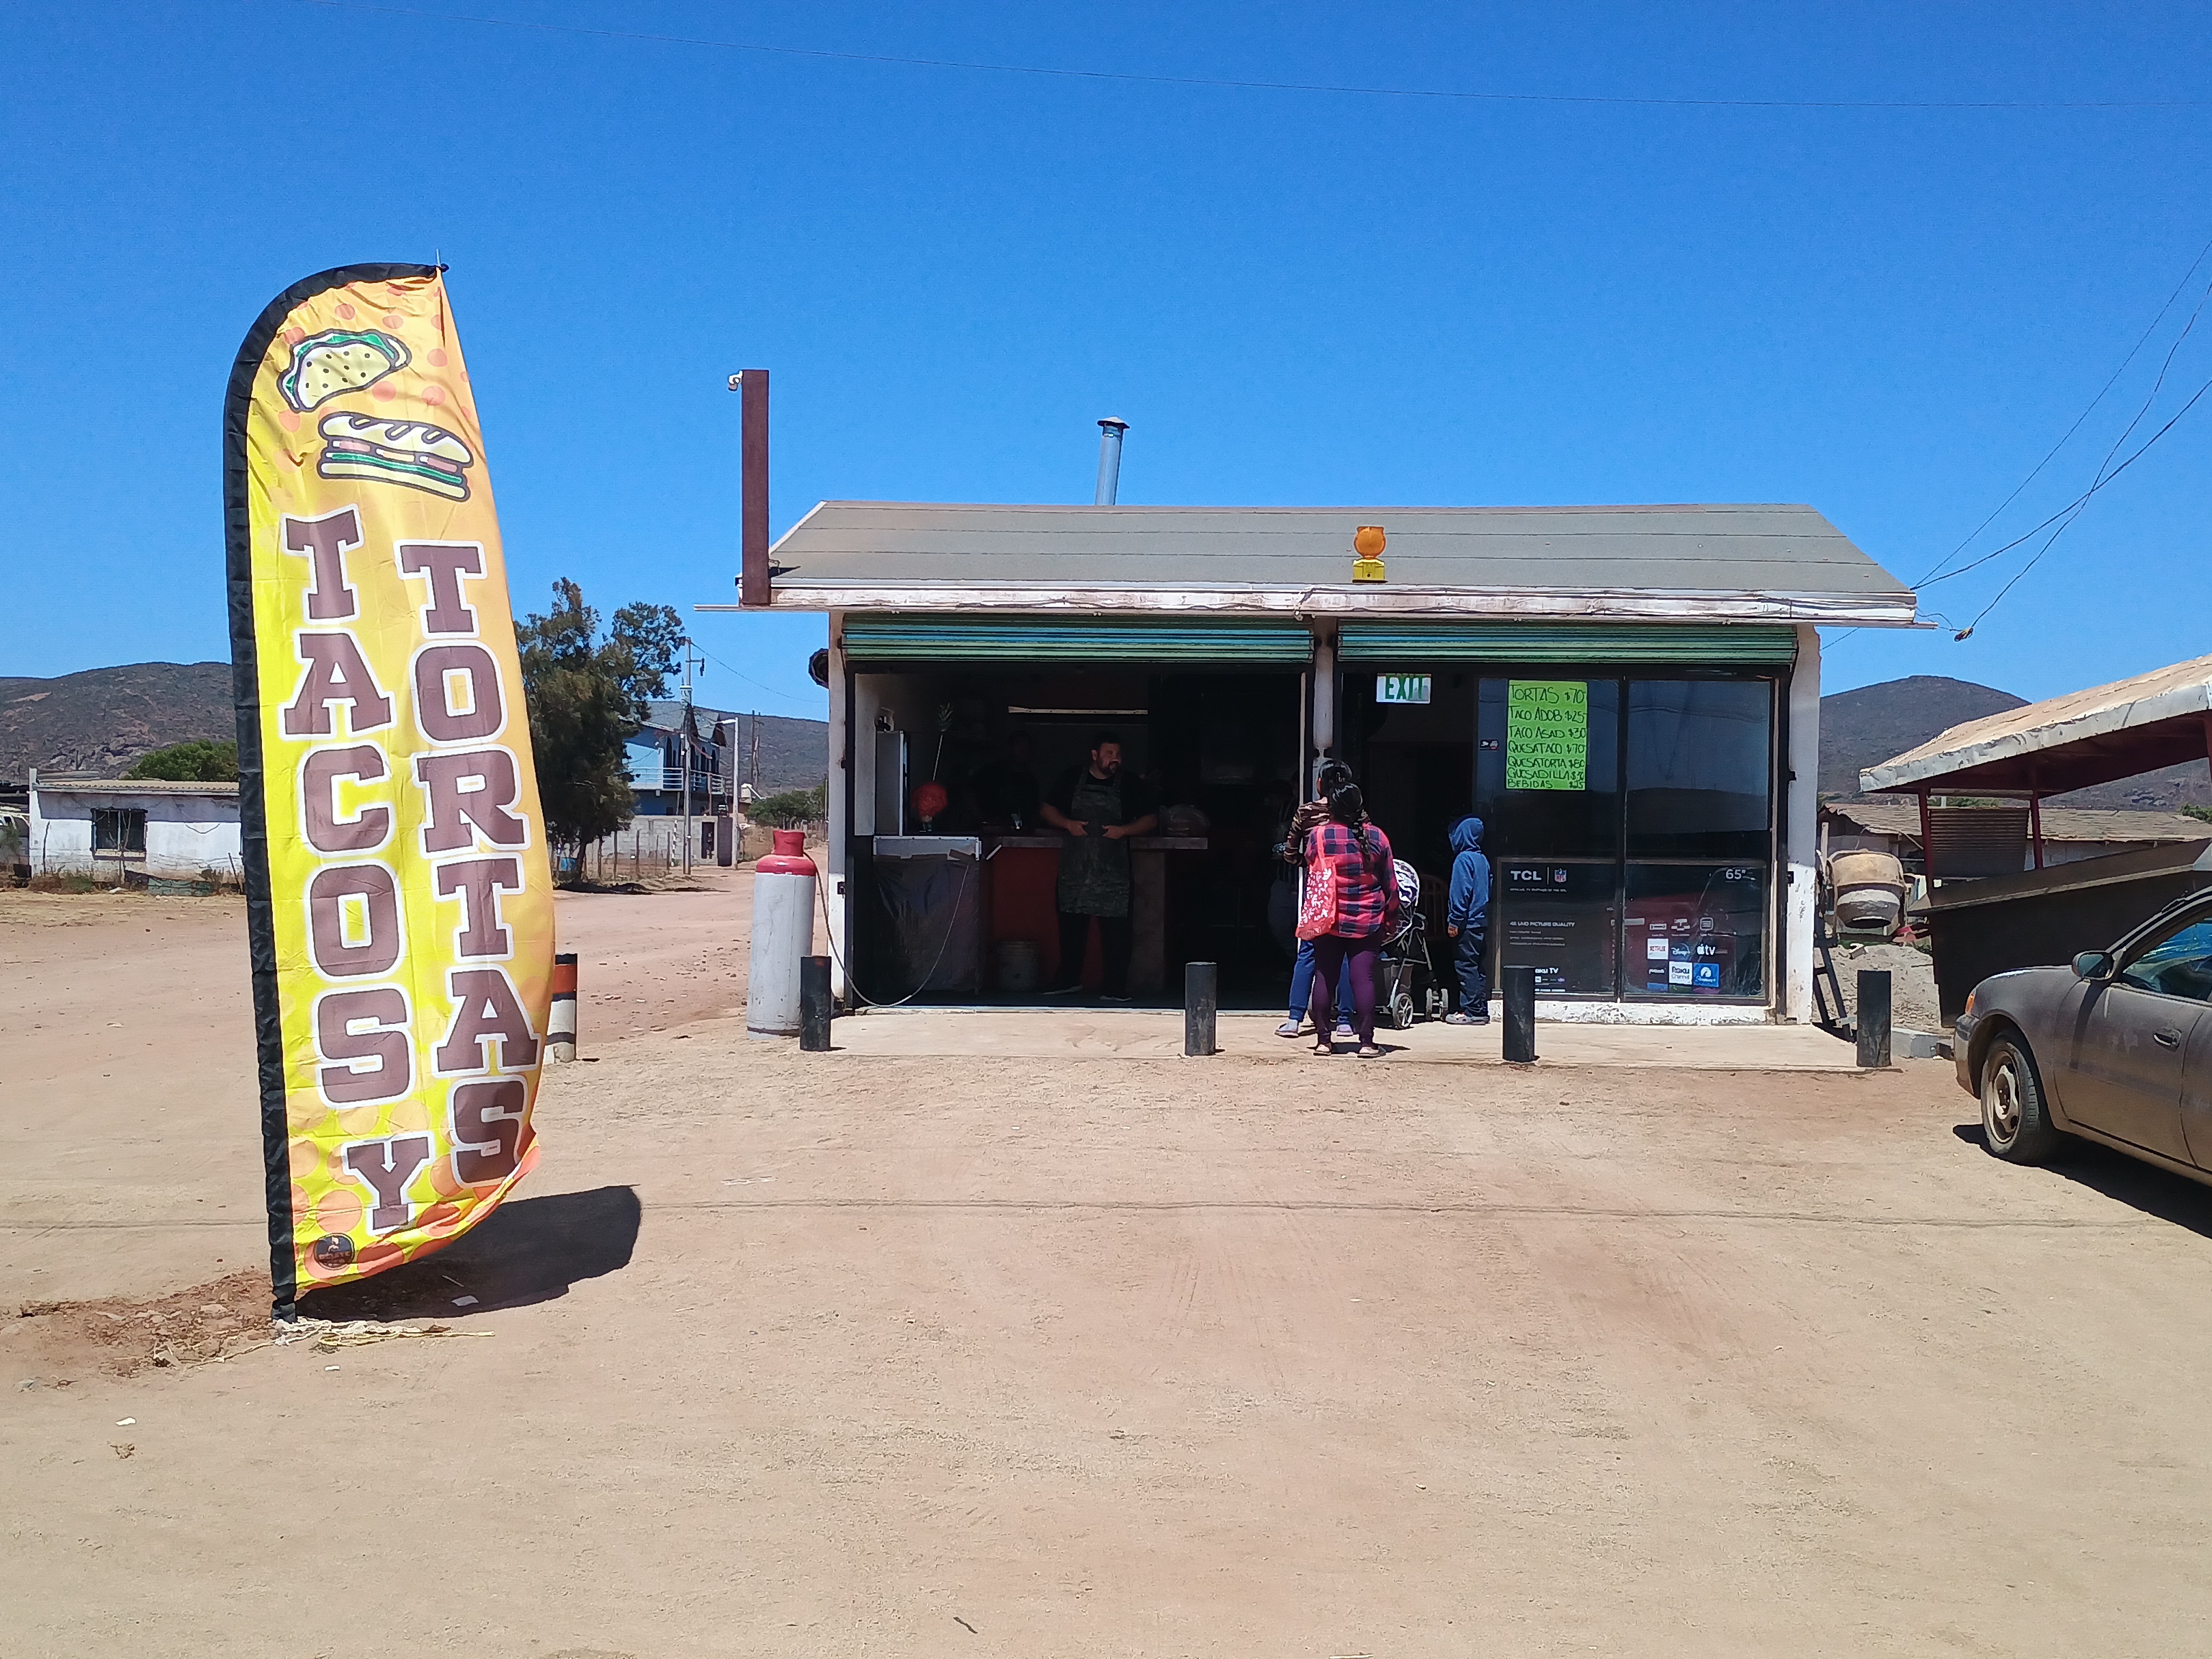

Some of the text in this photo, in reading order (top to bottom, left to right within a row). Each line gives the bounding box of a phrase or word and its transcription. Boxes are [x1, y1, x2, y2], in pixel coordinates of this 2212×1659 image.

[1385, 674, 1427, 699] EXIT
[1510, 684, 1586, 704] TORTAS $70
[1508, 705, 1532, 720] TACO
[1565, 710, 1587, 723] $25
[1509, 725, 1533, 739] TACO
[1568, 727, 1586, 739] $30
[1508, 740, 1562, 754] QUESATACO
[1566, 743, 1586, 754] $70
[1507, 756, 1585, 768] QUESATORTA $80
[1507, 767, 1569, 780] QUESADILLA
[1507, 778, 1553, 788] BEBIDAS
[282, 507, 432, 1232] TACOS Y
[397, 543, 541, 1186] TORTAS
[1510, 870, 1542, 880] TCL
